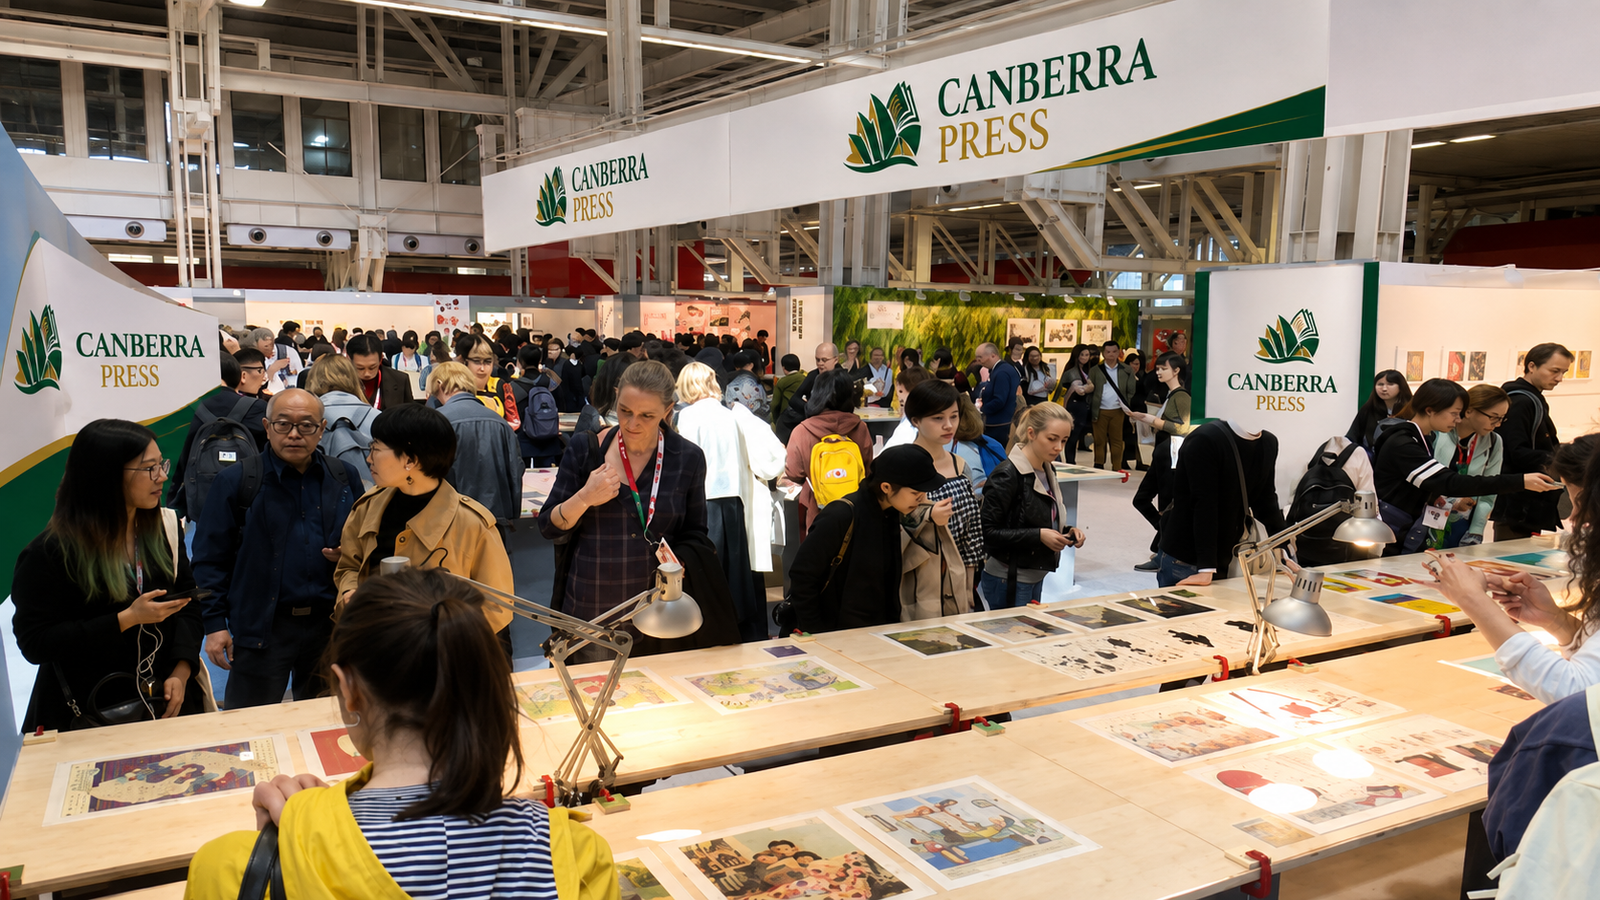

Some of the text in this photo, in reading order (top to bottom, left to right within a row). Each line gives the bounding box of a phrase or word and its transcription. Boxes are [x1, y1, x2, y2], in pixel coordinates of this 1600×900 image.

[938, 38, 1157, 117] CANBERRA
[939, 109, 1048, 163] PRESS
[572, 153, 648, 192] CANBERRA
[573, 191, 613, 222] PRESS
[76, 332, 205, 358] CANBERRA
[101, 365, 159, 387] PRESS
[1228, 373, 1337, 393] CANBERRA
[1256, 395, 1305, 411] PRESS
